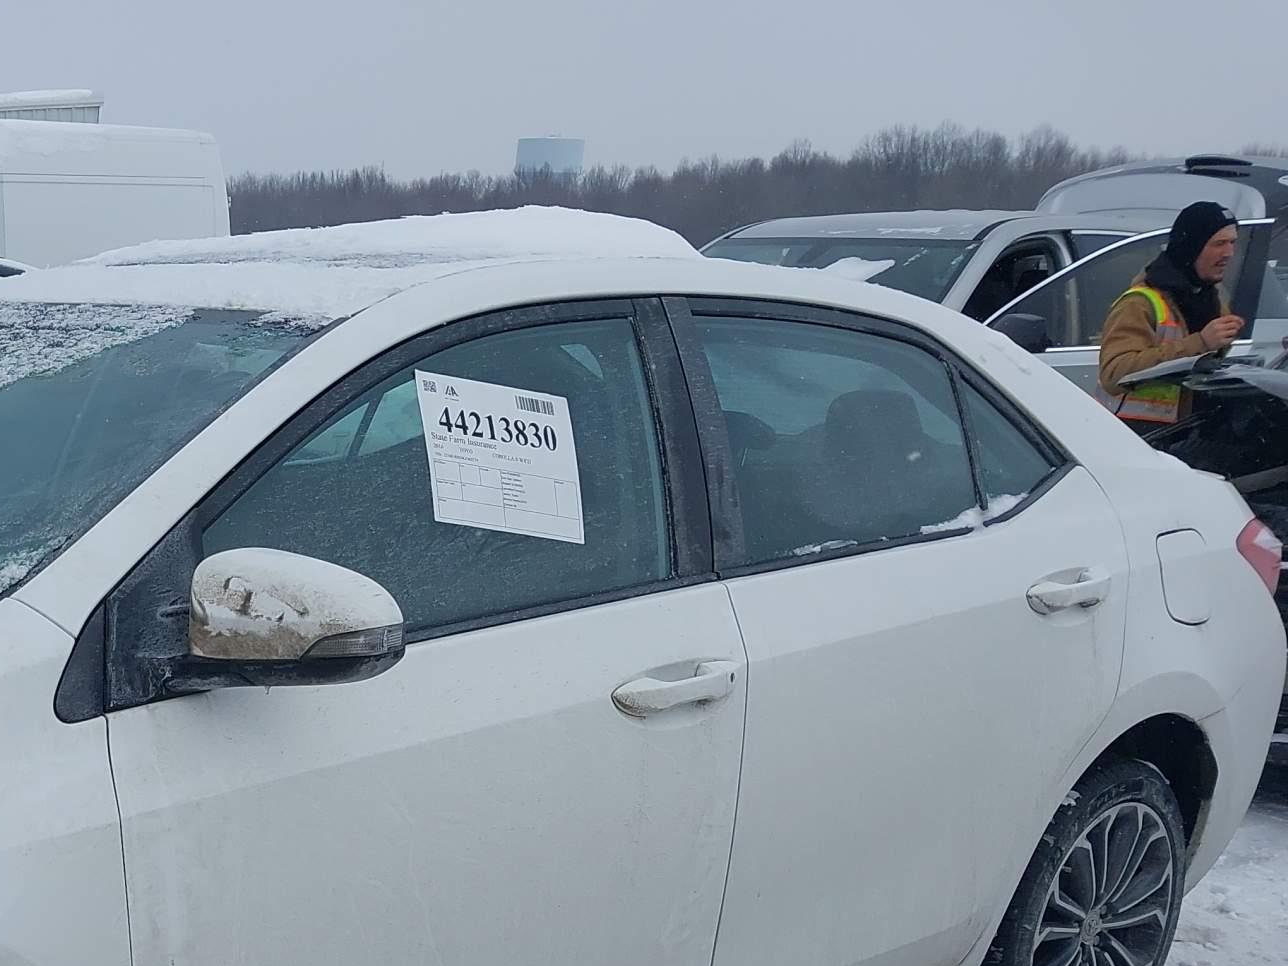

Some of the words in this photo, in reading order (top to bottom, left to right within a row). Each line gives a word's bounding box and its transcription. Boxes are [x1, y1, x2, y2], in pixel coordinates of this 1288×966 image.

[431, 431, 448, 442] State
[449, 435, 466, 445] Farm
[439, 407, 557, 451] 44213830
